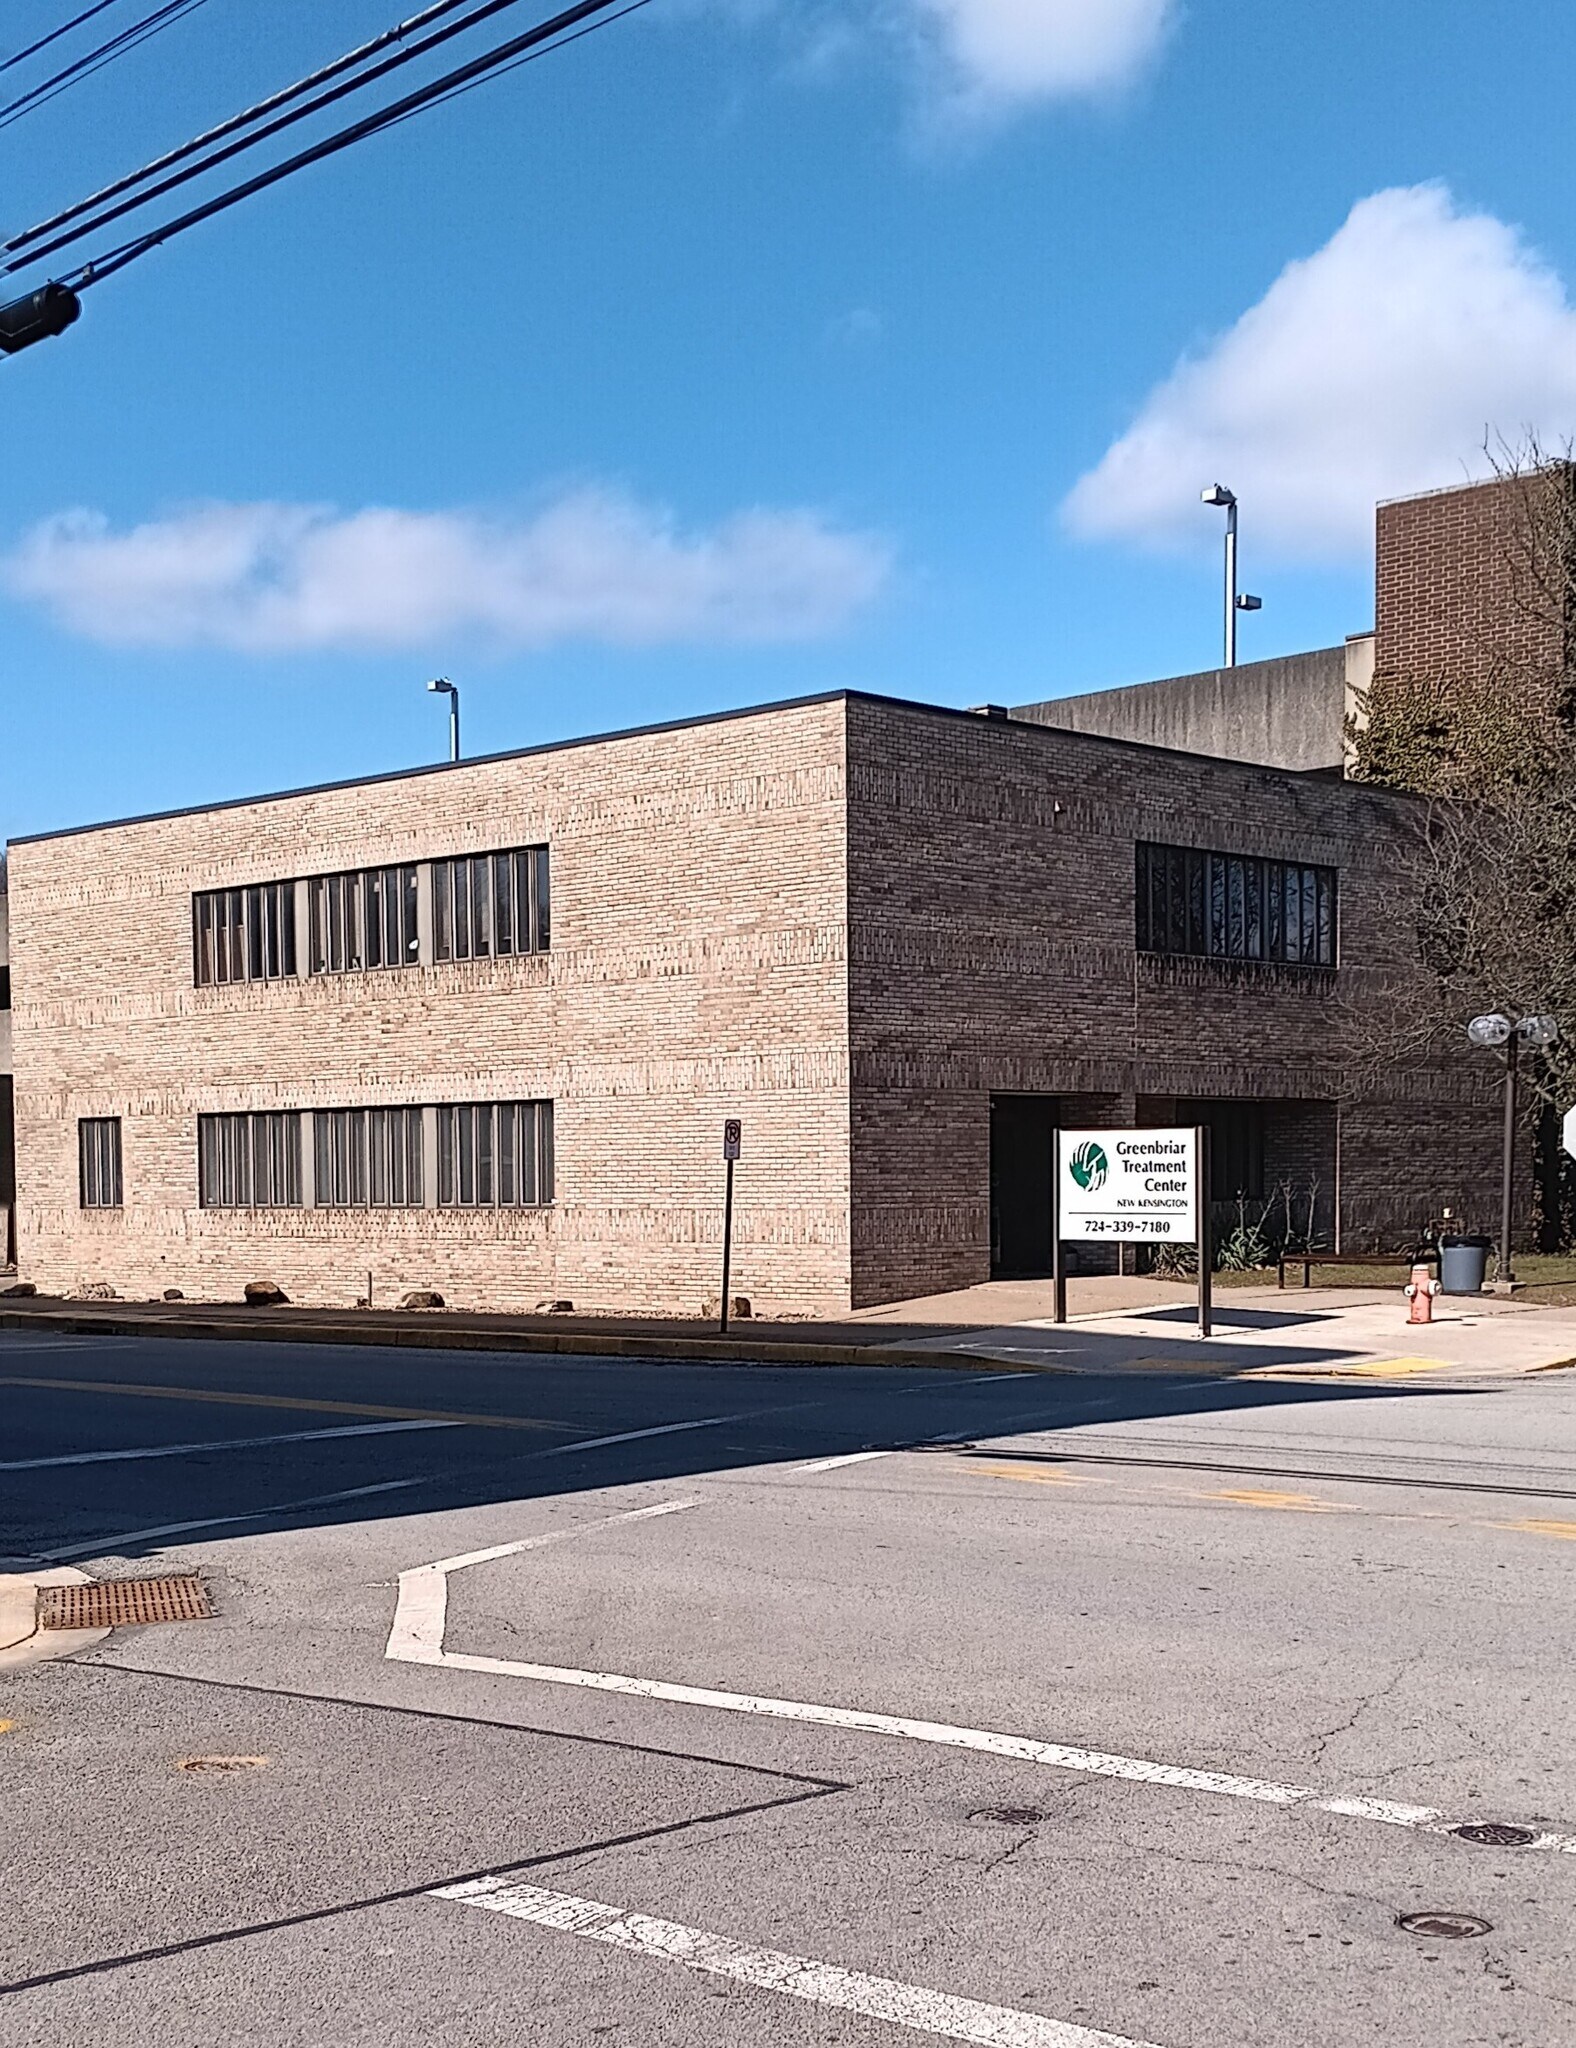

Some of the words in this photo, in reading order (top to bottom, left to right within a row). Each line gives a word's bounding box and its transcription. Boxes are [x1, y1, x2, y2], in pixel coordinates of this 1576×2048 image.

[1116, 1140, 1186, 1155] Greenbriar
[1122, 1159, 1187, 1173] Treatment
[1144, 1178, 1187, 1192] Center
[1117, 1199, 1136, 1207] NEW
[1138, 1199, 1188, 1208] KENSINGTON
[1085, 1220, 1171, 1233] 724-339-7180
